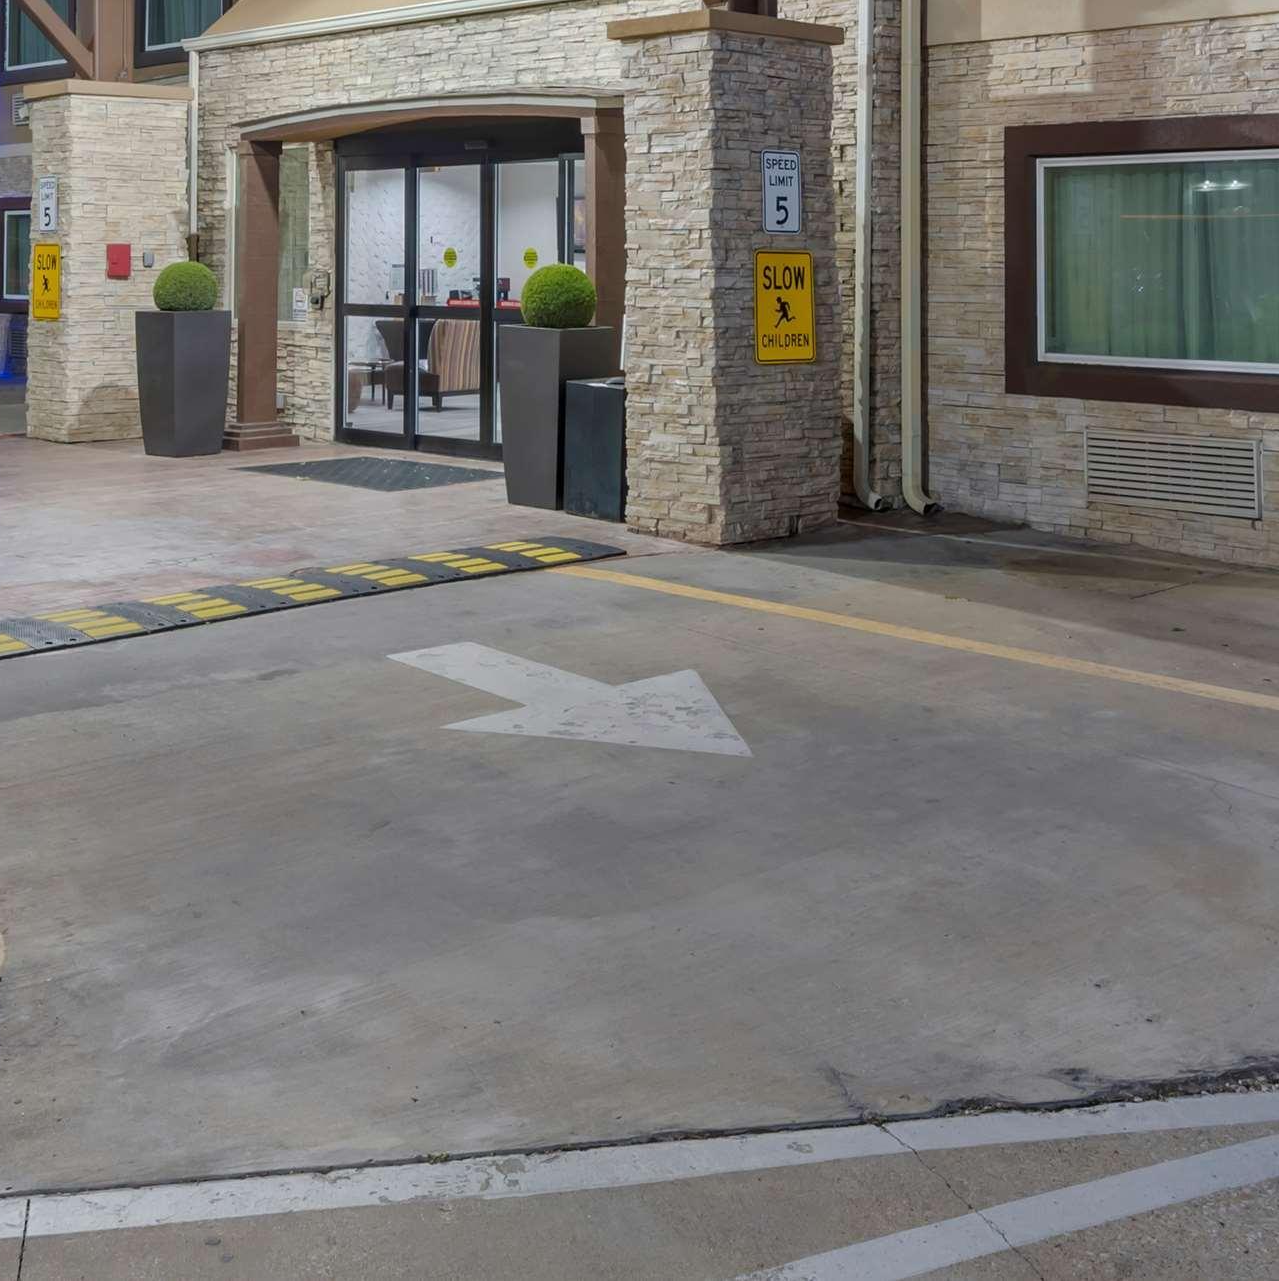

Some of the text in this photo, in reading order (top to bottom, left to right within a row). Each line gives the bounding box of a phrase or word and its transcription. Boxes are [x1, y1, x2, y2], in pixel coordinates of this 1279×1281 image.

[765, 158, 797, 171] SPEED
[769, 175, 794, 188] LIMIT
[43, 207, 51, 227] 5
[775, 196, 789, 225] 5
[36, 253, 57, 270] SLOW
[762, 265, 806, 291] SLOW
[761, 332, 810, 349] CHILDREN
